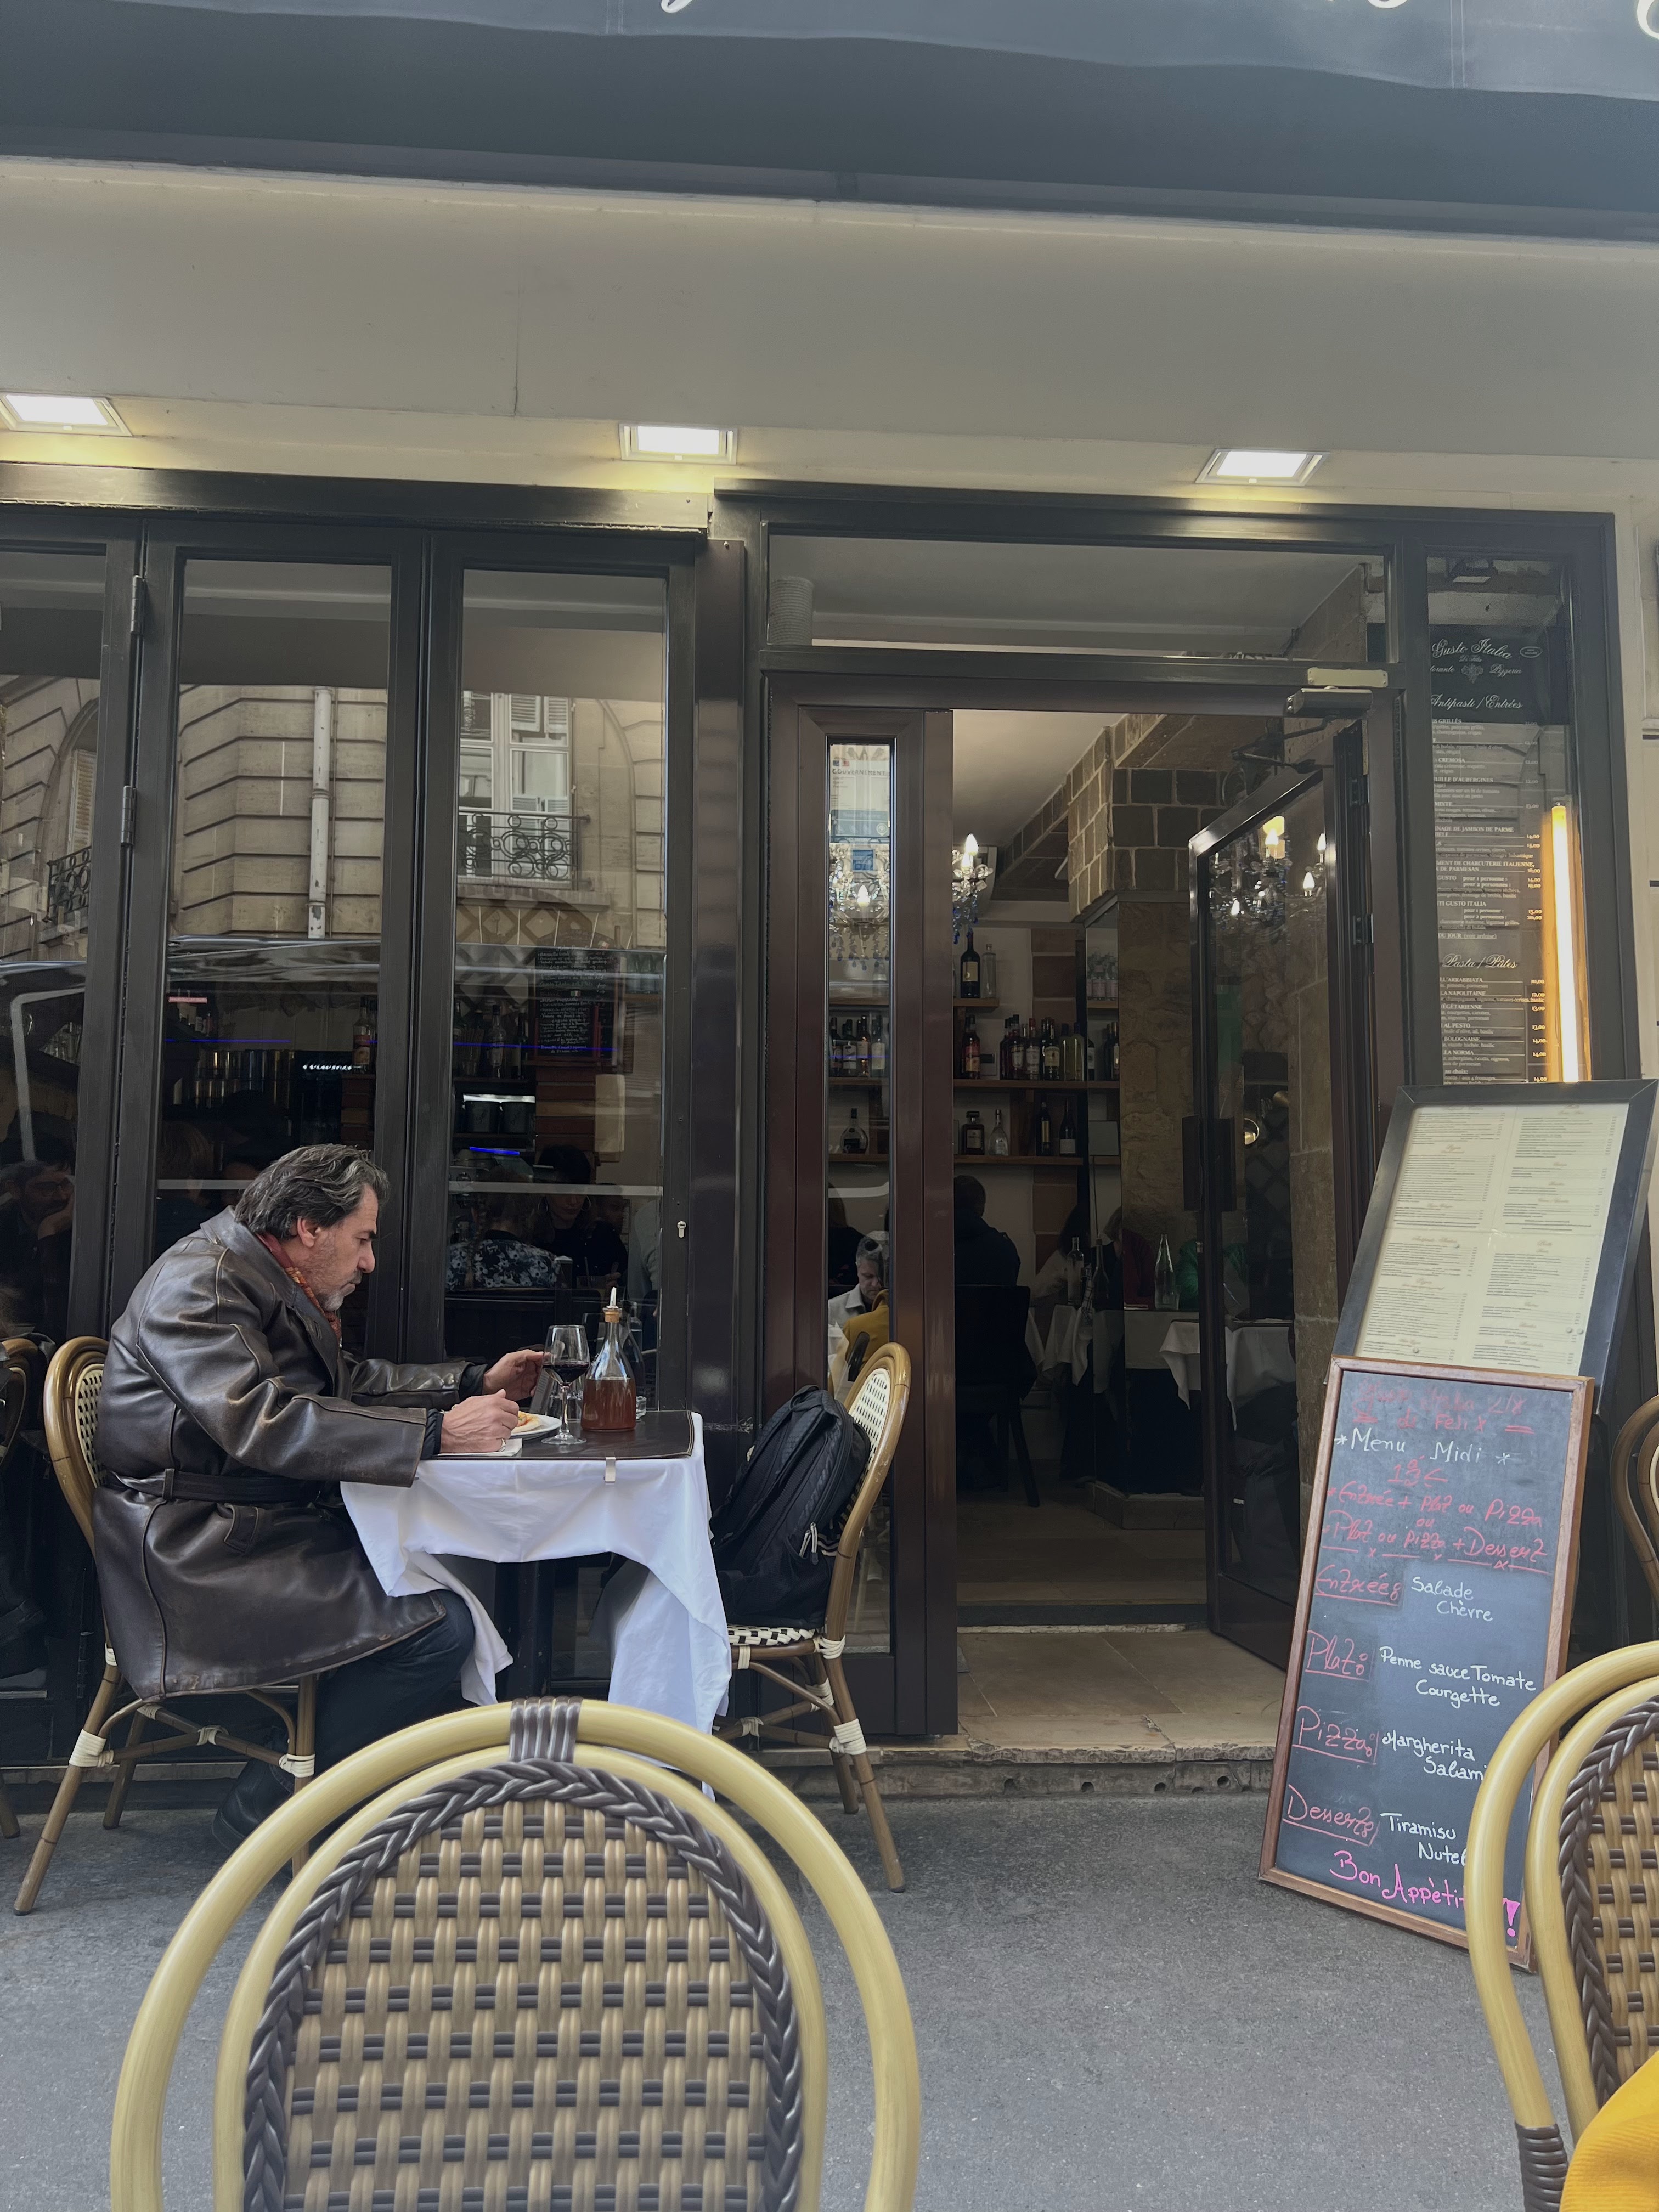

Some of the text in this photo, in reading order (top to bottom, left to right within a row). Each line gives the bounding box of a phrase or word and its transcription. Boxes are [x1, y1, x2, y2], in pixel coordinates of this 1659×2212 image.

[1432, 638, 1512, 659] Gusto Italia
[1489, 663, 1522, 677] Pizzeria
[1431, 694, 1475, 710] Antipasti
[1486, 695, 1522, 709] Entrées
[1442, 953, 1476, 968] Pasta
[1485, 954, 1518, 968] Pâtes
[1351, 1427, 1482, 1463] Menu Midi
[1339, 1481, 1394, 1507] Entrée
[1420, 1495, 1453, 1513] Plat
[1459, 1503, 1474, 1513] ou
[1485, 1499, 1543, 1528] Pizza
[1328, 1509, 1373, 1543] Plat
[1378, 1532, 1397, 1543] ou
[1403, 1530, 1447, 1549] Pizza
[1463, 1526, 1548, 1562] Dessert
[1417, 1517, 1436, 1528] ou
[1411, 1576, 1474, 1600] Salade
[1436, 1599, 1493, 1622] Chèvre
[1379, 1645, 1537, 1692] Penne sauce Tomate
[1415, 1679, 1500, 1709] Courgette
[1381, 1729, 1476, 1761] Margherita
[1423, 1755, 1488, 1781] Salam
[1380, 1812, 1457, 1841] Tiramisu
[1418, 1842, 1468, 1866] Nutel
[1329, 1850, 1521, 1937] Bon Appèti !
